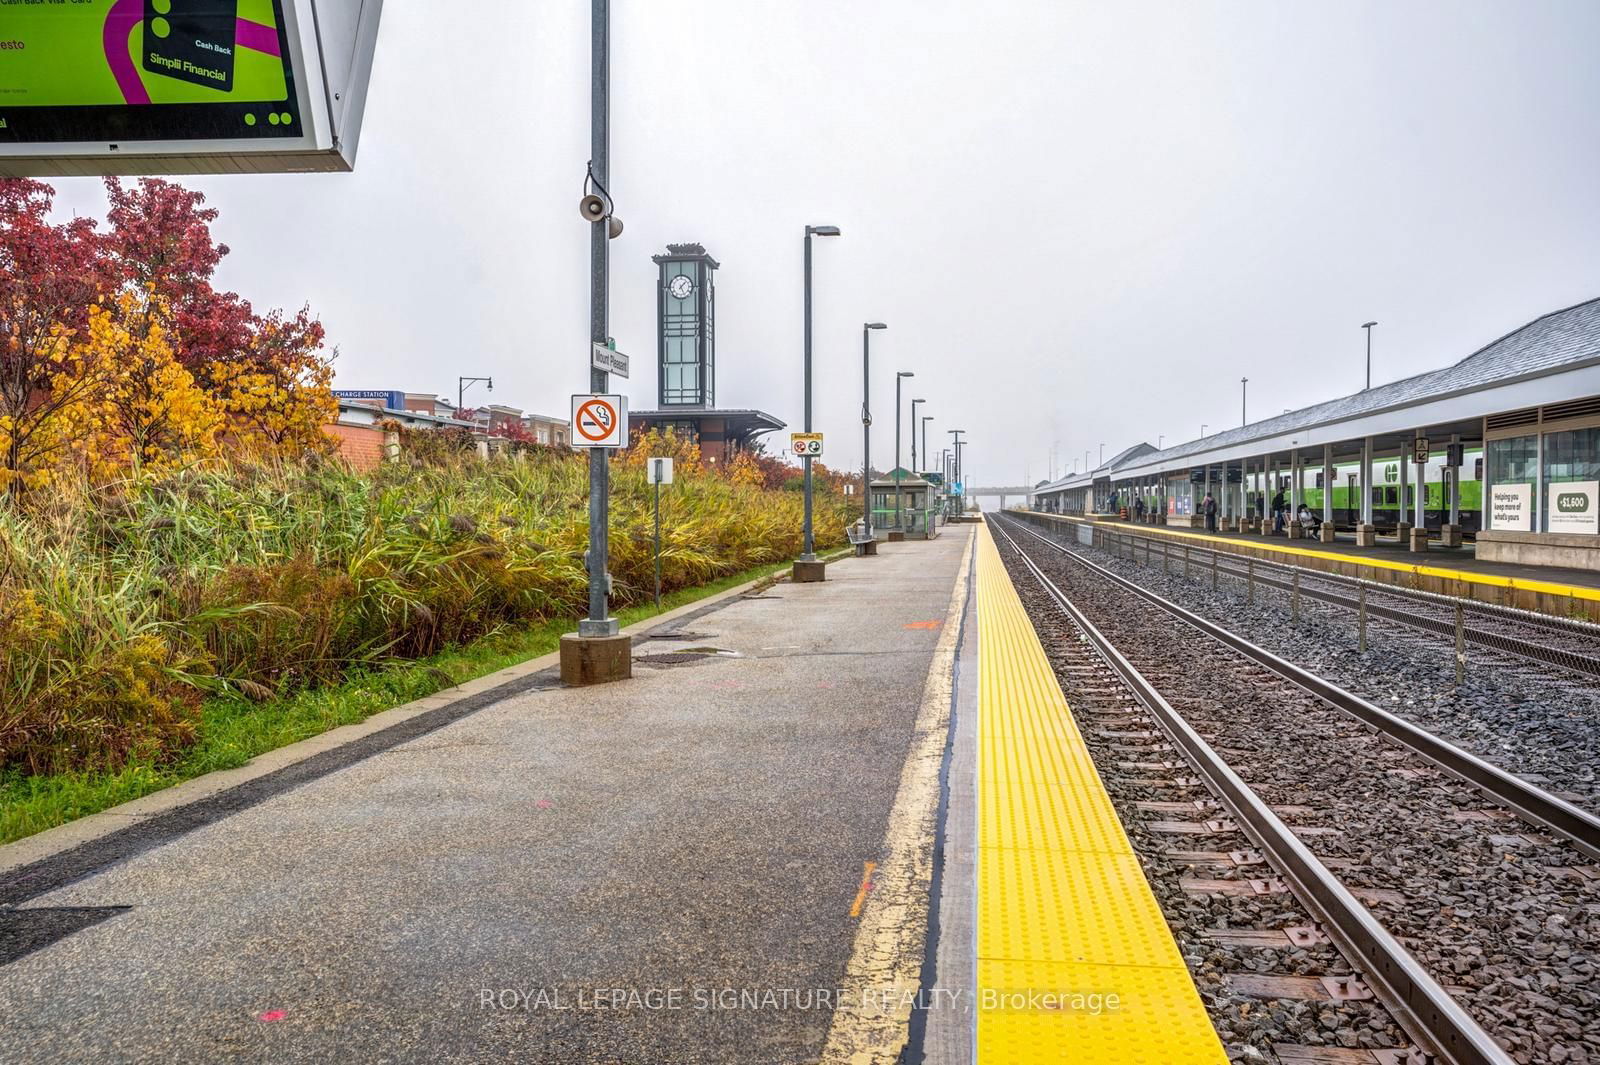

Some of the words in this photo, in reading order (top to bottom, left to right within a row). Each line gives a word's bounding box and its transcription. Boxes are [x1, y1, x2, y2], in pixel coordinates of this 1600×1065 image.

[195, 39, 213, 51] Cash
[214, 44, 232, 56] Back
[150, 52, 182, 70] Simplii
[183, 61, 226, 82] Financial
[595, 348, 610, 366] Mount
[610, 354, 627, 373] Pleasant
[1385, 463, 1398, 483] GO
[1494, 492, 1510, 503] Helping
[1511, 493, 1519, 503] you
[1494, 502, 1505, 512] keep
[1516, 502, 1522, 511] of
[1508, 514, 1520, 523] yours
